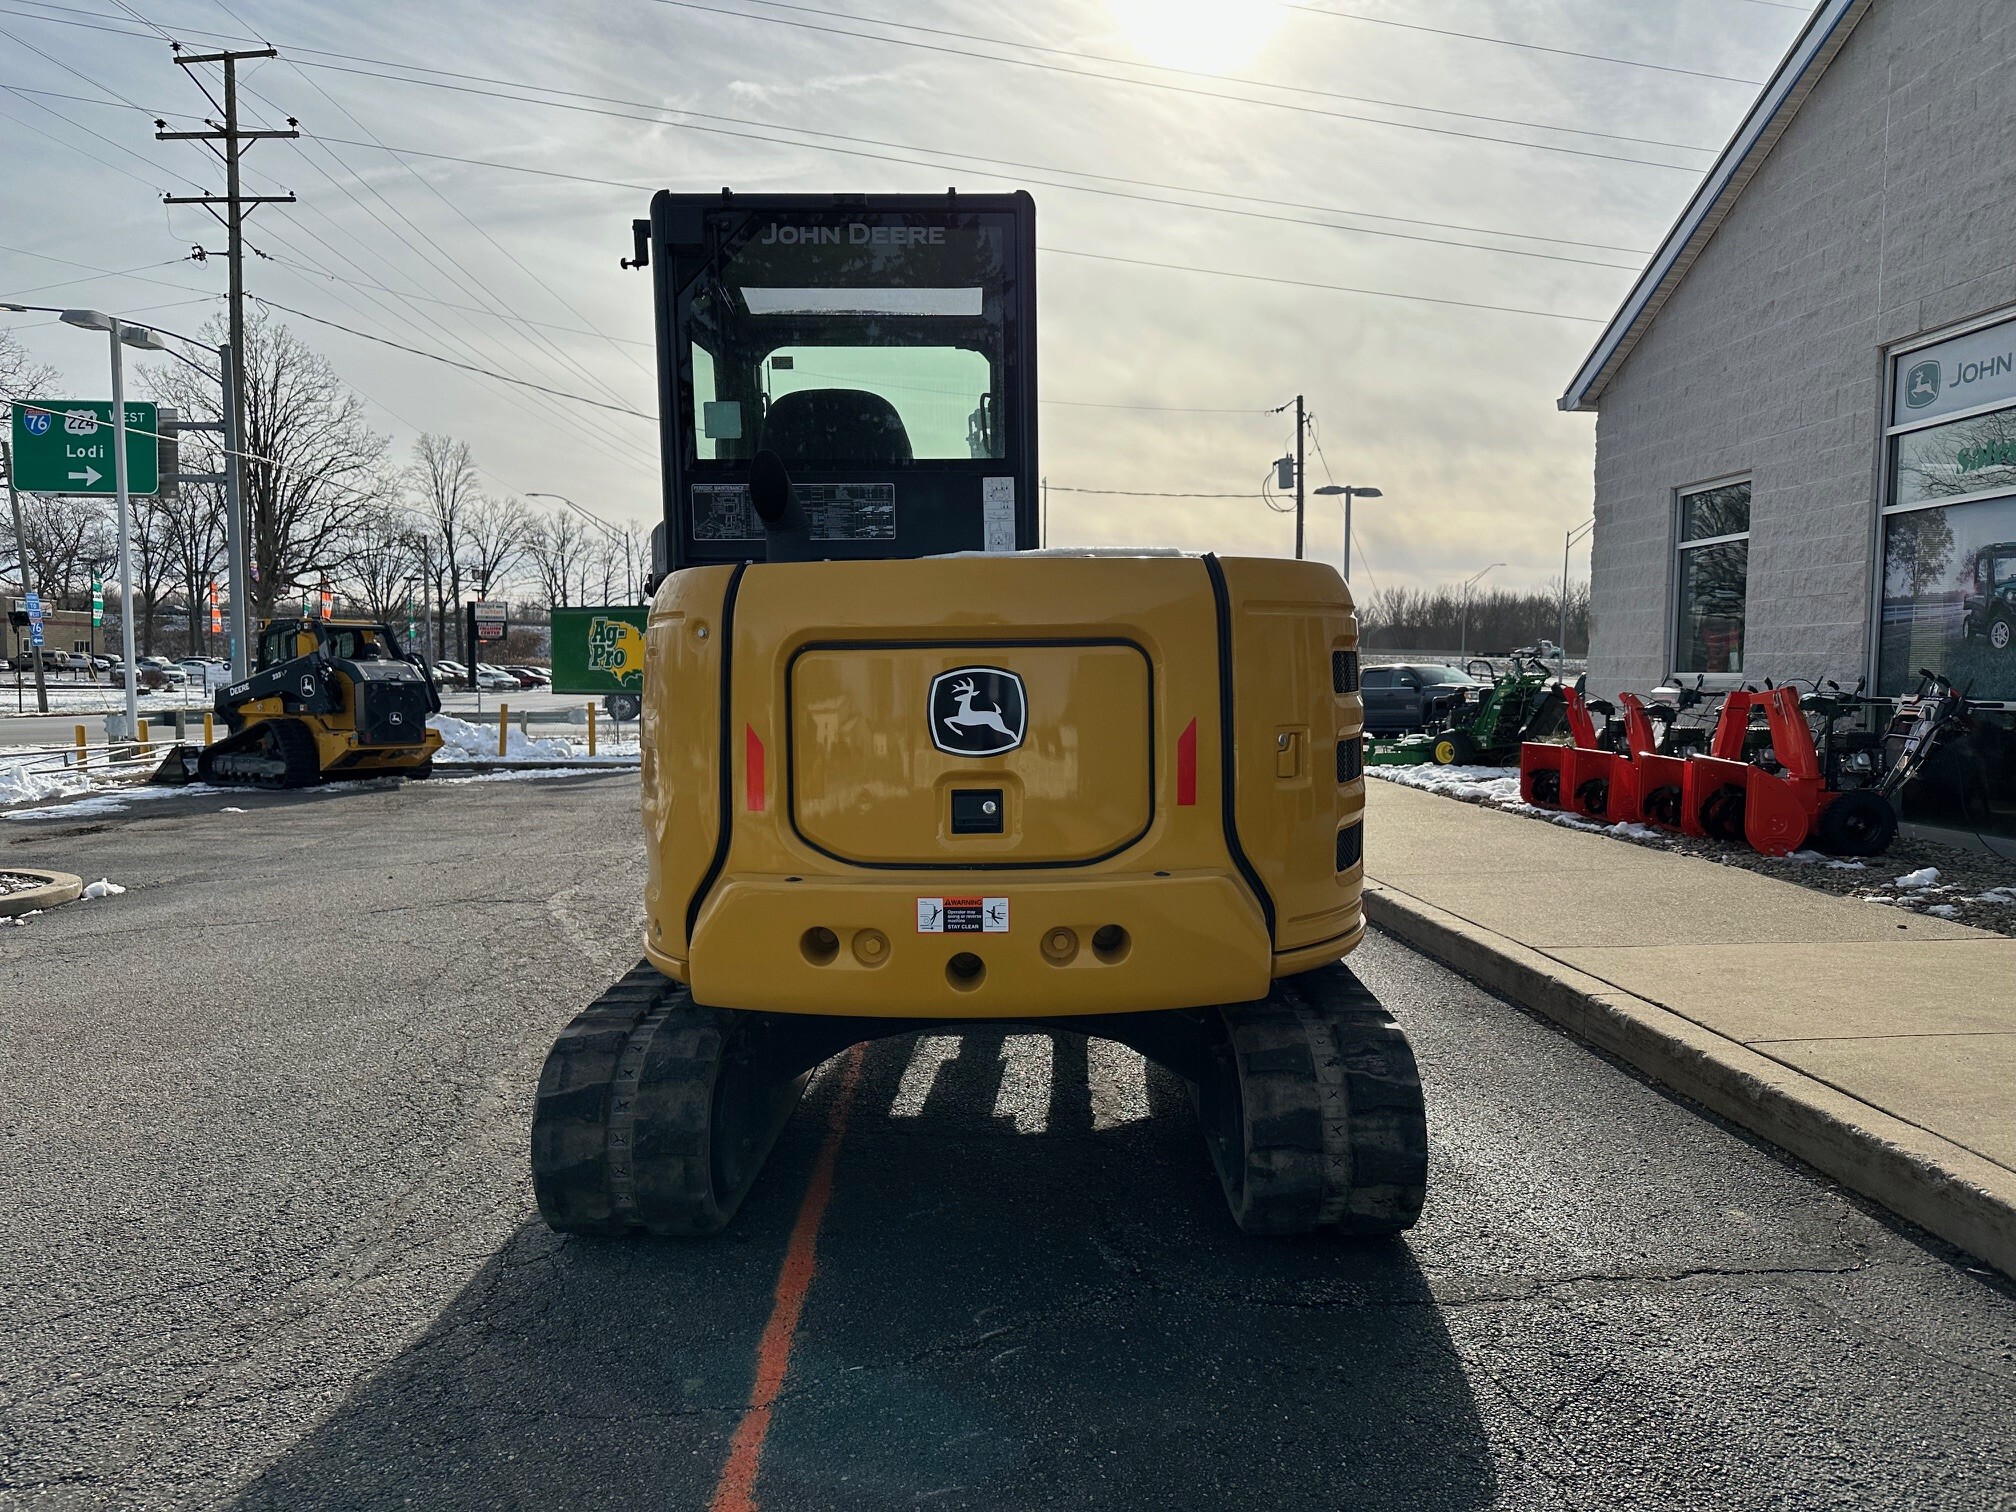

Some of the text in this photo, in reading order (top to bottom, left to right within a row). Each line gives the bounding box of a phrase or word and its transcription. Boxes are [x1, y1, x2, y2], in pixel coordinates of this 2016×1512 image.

[761, 222, 946, 245] JOHN DEERE
[1949, 352, 2013, 389] JOHN
[27, 415, 48, 431] 76
[68, 415, 95, 430] 224
[66, 444, 104, 459] Lodi
[32, 622, 42, 632] 76
[591, 618, 626, 649] Ag-
[590, 644, 626, 668] Pro
[229, 682, 250, 697] DEERE
